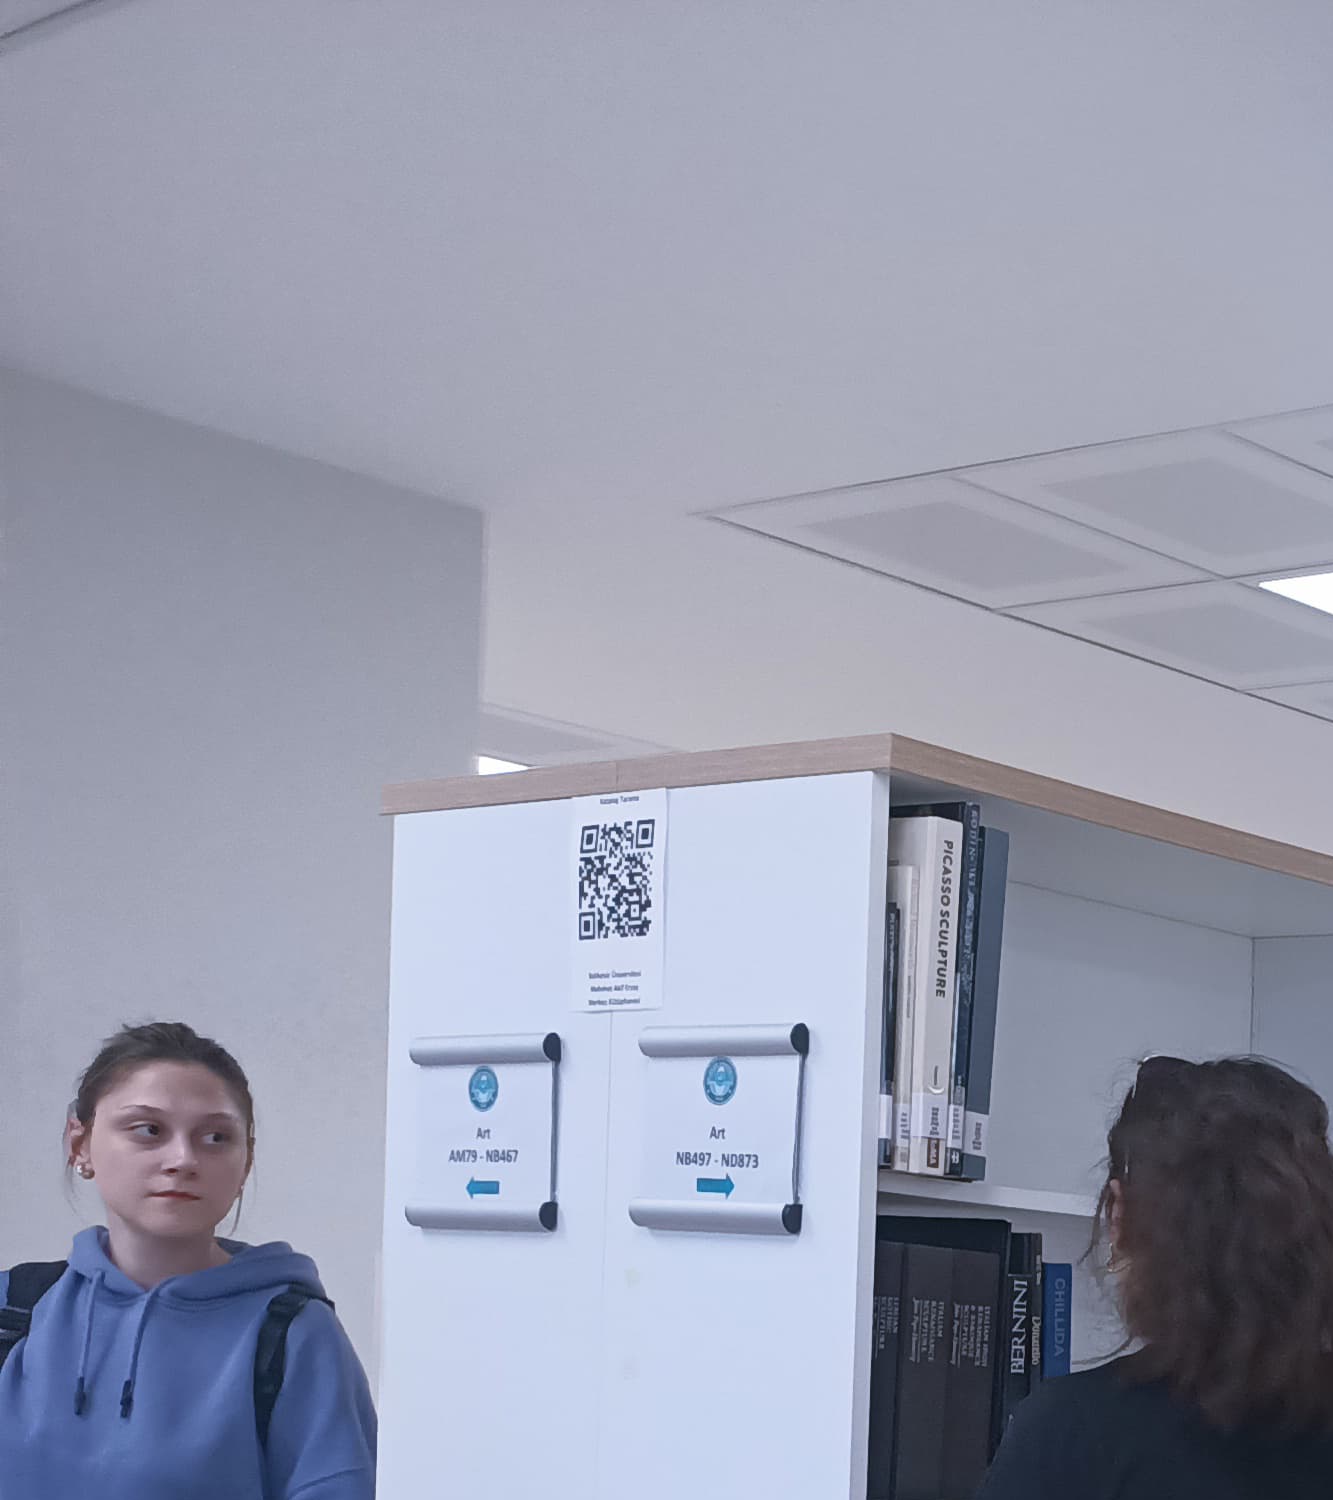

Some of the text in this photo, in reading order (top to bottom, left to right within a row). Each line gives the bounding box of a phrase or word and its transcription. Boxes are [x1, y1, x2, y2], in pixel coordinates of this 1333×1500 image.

[936, 840, 954, 998] PICASSO SCULPTURE
[476, 1127, 491, 1139] Art
[709, 1126, 726, 1140] Art
[448, 1149, 478, 1163] AM79
[486, 1149, 519, 1163] NB467
[676, 1151, 712, 1167] NB497
[721, 1153, 759, 1169] ND873
[1053, 1277, 1067, 1357] CHILLIDA
[1010, 1280, 1028, 1374] BERNINI
